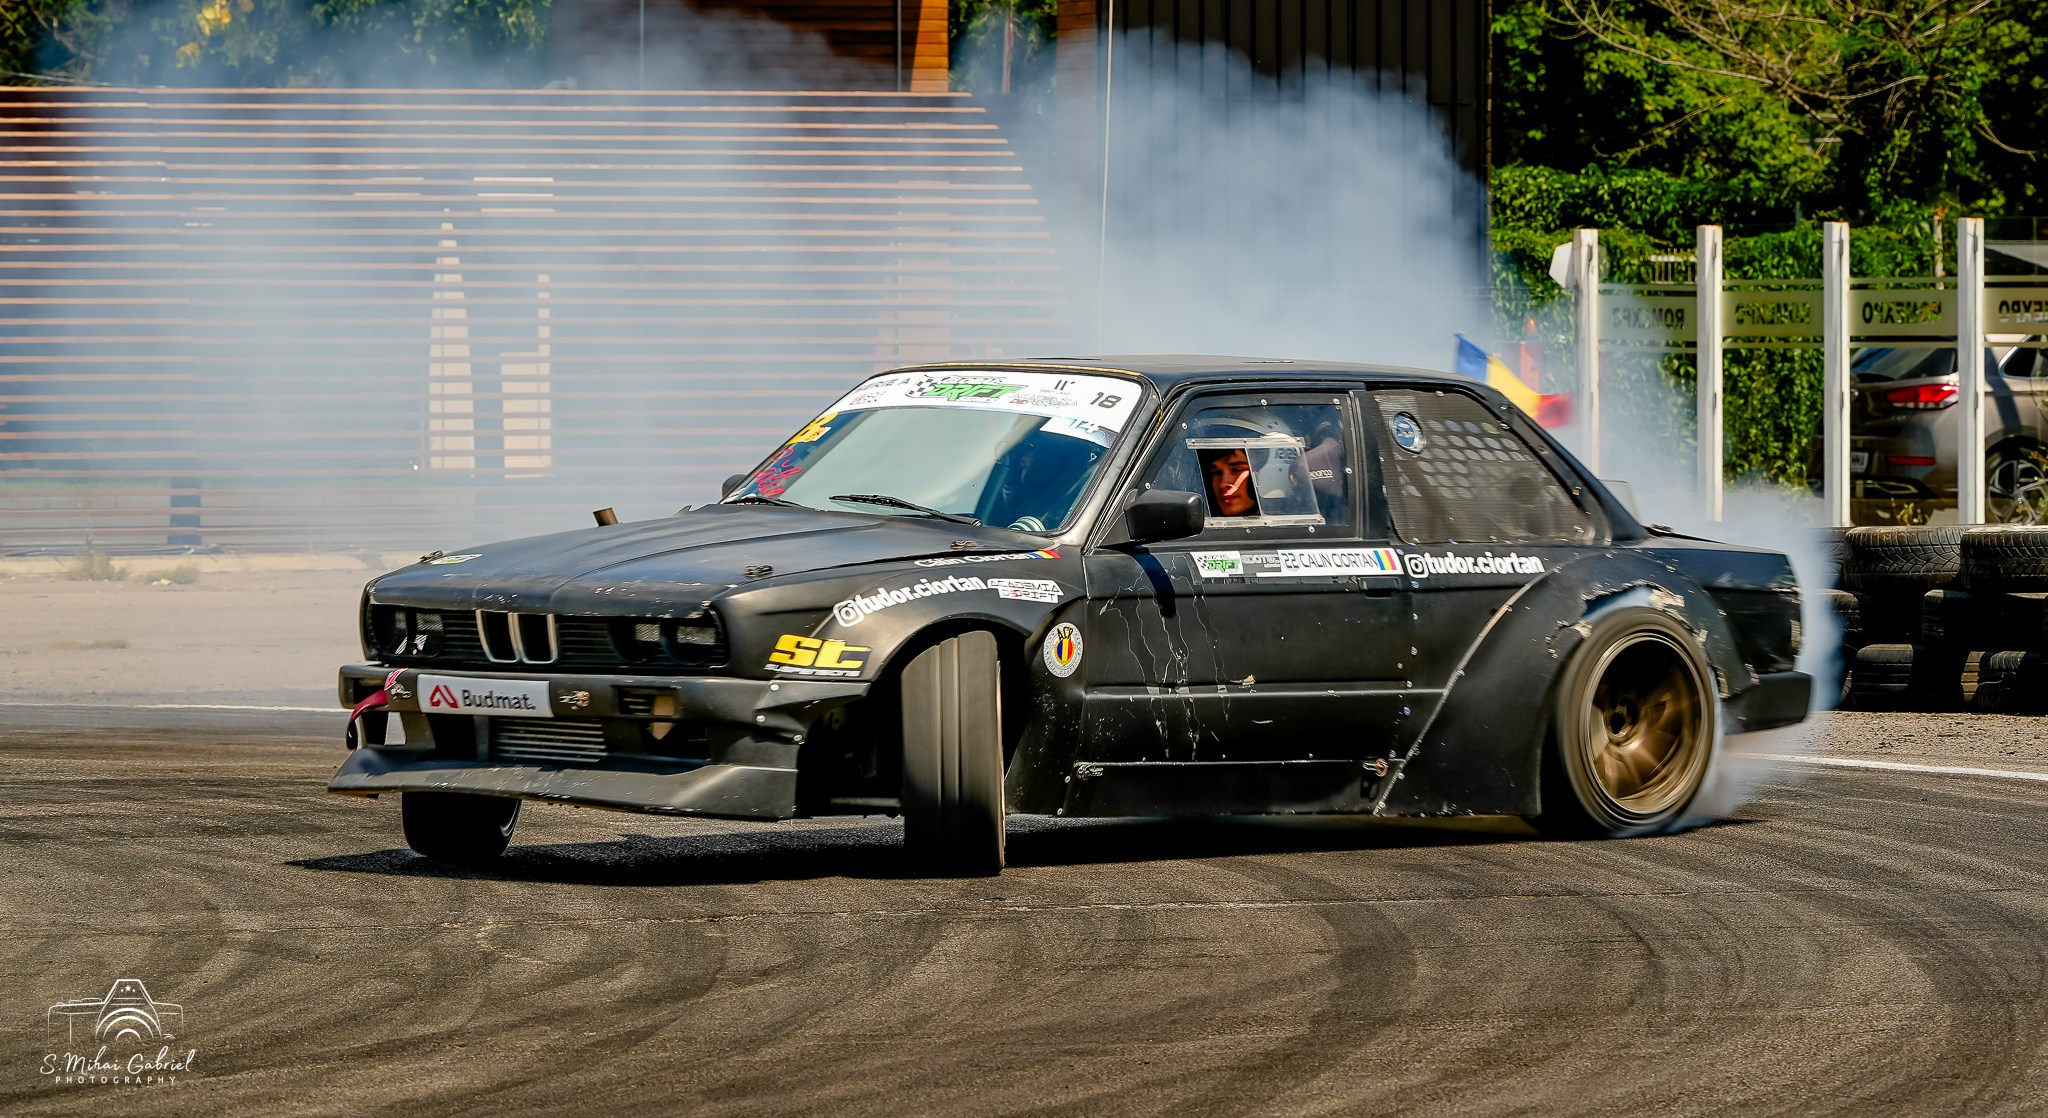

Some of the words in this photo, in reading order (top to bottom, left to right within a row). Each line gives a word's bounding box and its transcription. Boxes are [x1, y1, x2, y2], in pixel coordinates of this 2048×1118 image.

[920, 384, 1024, 401] DRIFT
[1090, 391, 1122, 409] 18
[963, 552, 1037, 562] Ciortan
[1281, 552, 1300, 569] 22
[1299, 553, 1332, 568] CALIN
[1331, 552, 1380, 568] CIORTAN
[1424, 551, 1546, 574] tudor.ciortan
[1208, 560, 1240, 572] DRIFT
[854, 575, 988, 615] tudor.ciortan
[990, 580, 1060, 593] ACADEMIA
